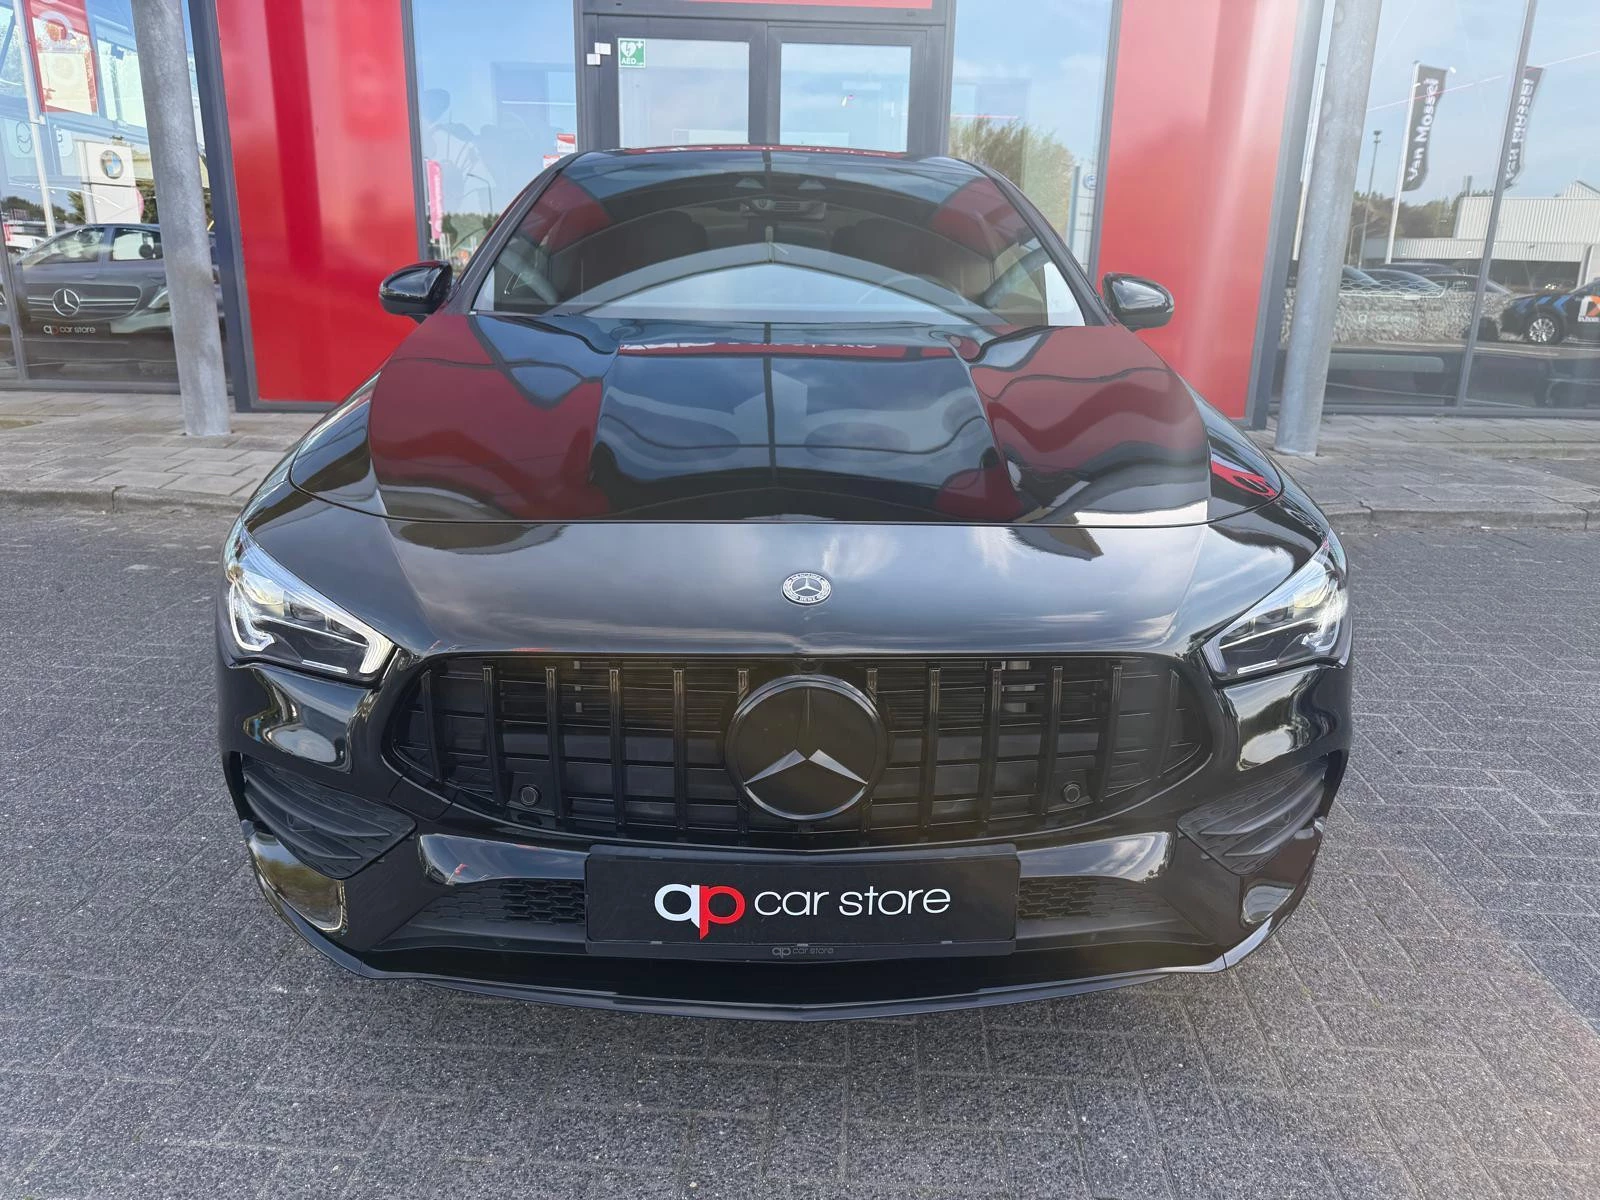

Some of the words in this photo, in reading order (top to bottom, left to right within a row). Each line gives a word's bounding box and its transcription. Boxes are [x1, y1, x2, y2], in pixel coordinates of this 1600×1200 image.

[621, 57, 637, 65] AED
[1415, 78, 1439, 142] Mossel
[1407, 147, 1424, 182] Van
[654, 883, 746, 940] ap
[754, 890, 830, 916] car
[838, 885, 951, 917] store
[792, 947, 809, 955] car
[810, 947, 834, 955] store
